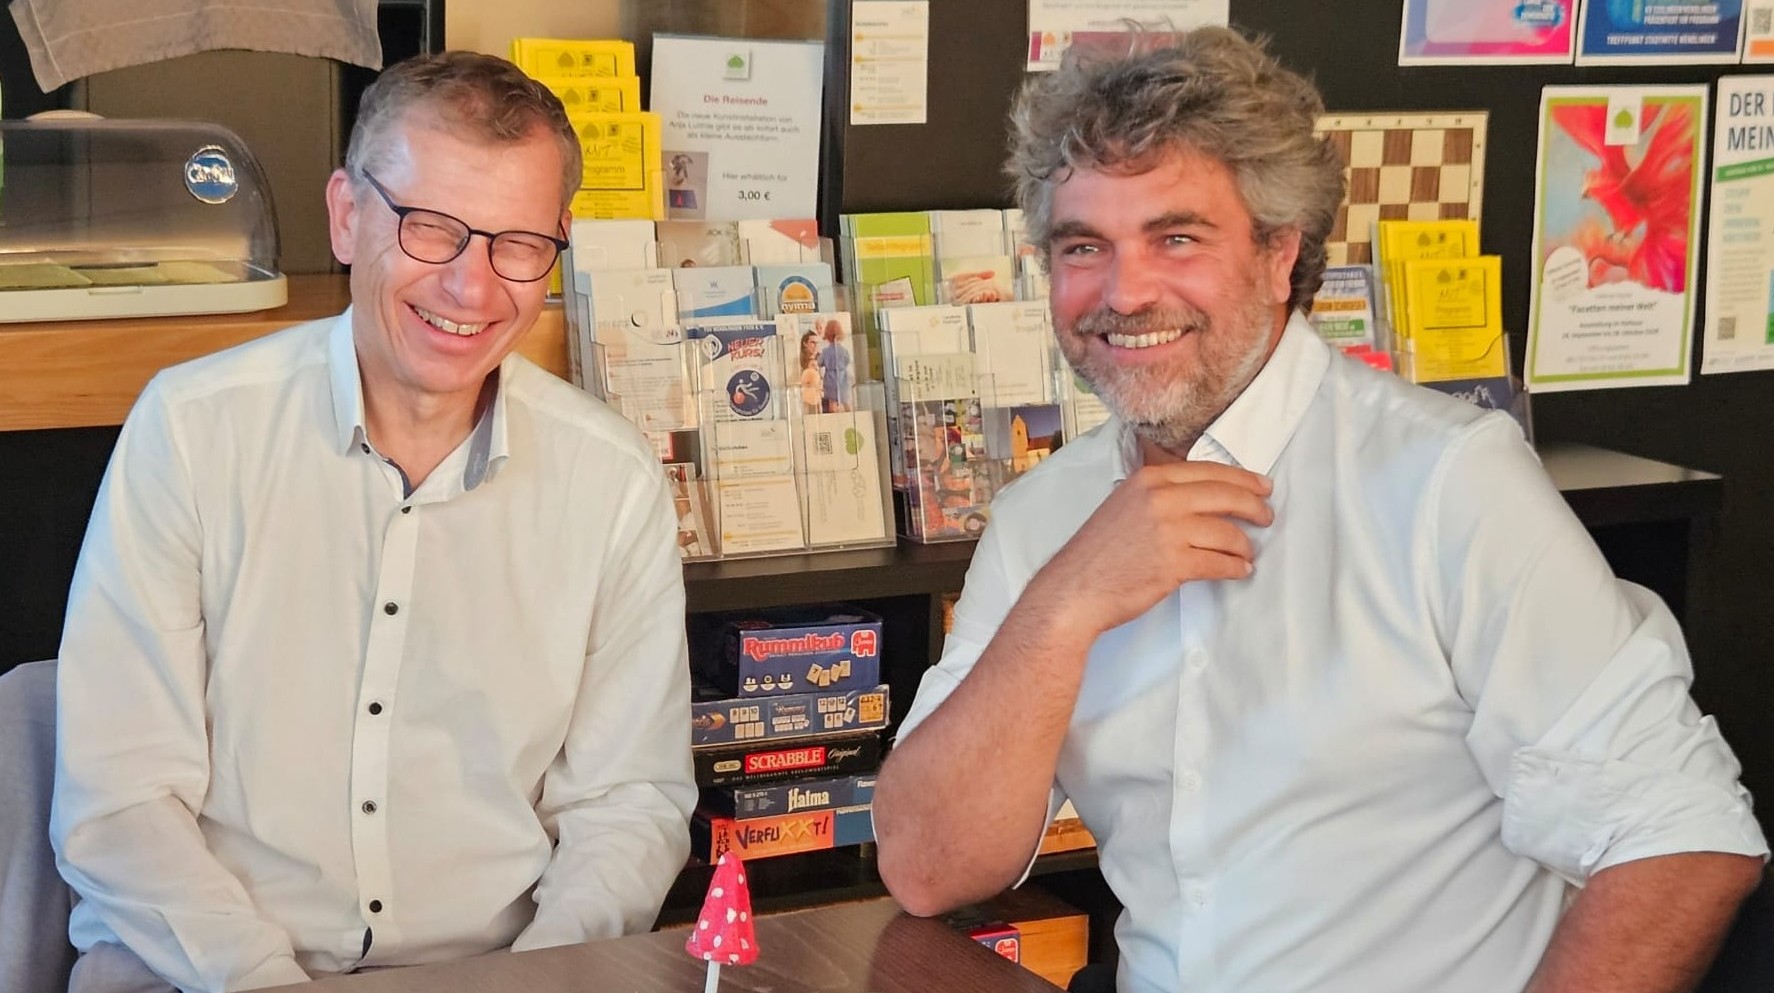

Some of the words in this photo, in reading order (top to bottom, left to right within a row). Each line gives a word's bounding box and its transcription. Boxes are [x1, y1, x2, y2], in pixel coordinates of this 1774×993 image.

[703, 95, 719, 105] Die
[722, 95, 768, 106] Reisende
[1729, 92, 1765, 117] DER
[722, 172, 738, 180] Hier
[740, 172, 775, 181] erhältlich
[738, 190, 761, 201] 3,00
[764, 191, 771, 201] €
[727, 337, 764, 352] NEUER
[743, 632, 845, 662] Rummikub
[749, 750, 821, 770] SCRABBLE
[827, 745, 862, 763] Original
[787, 786, 830, 813] Halma
